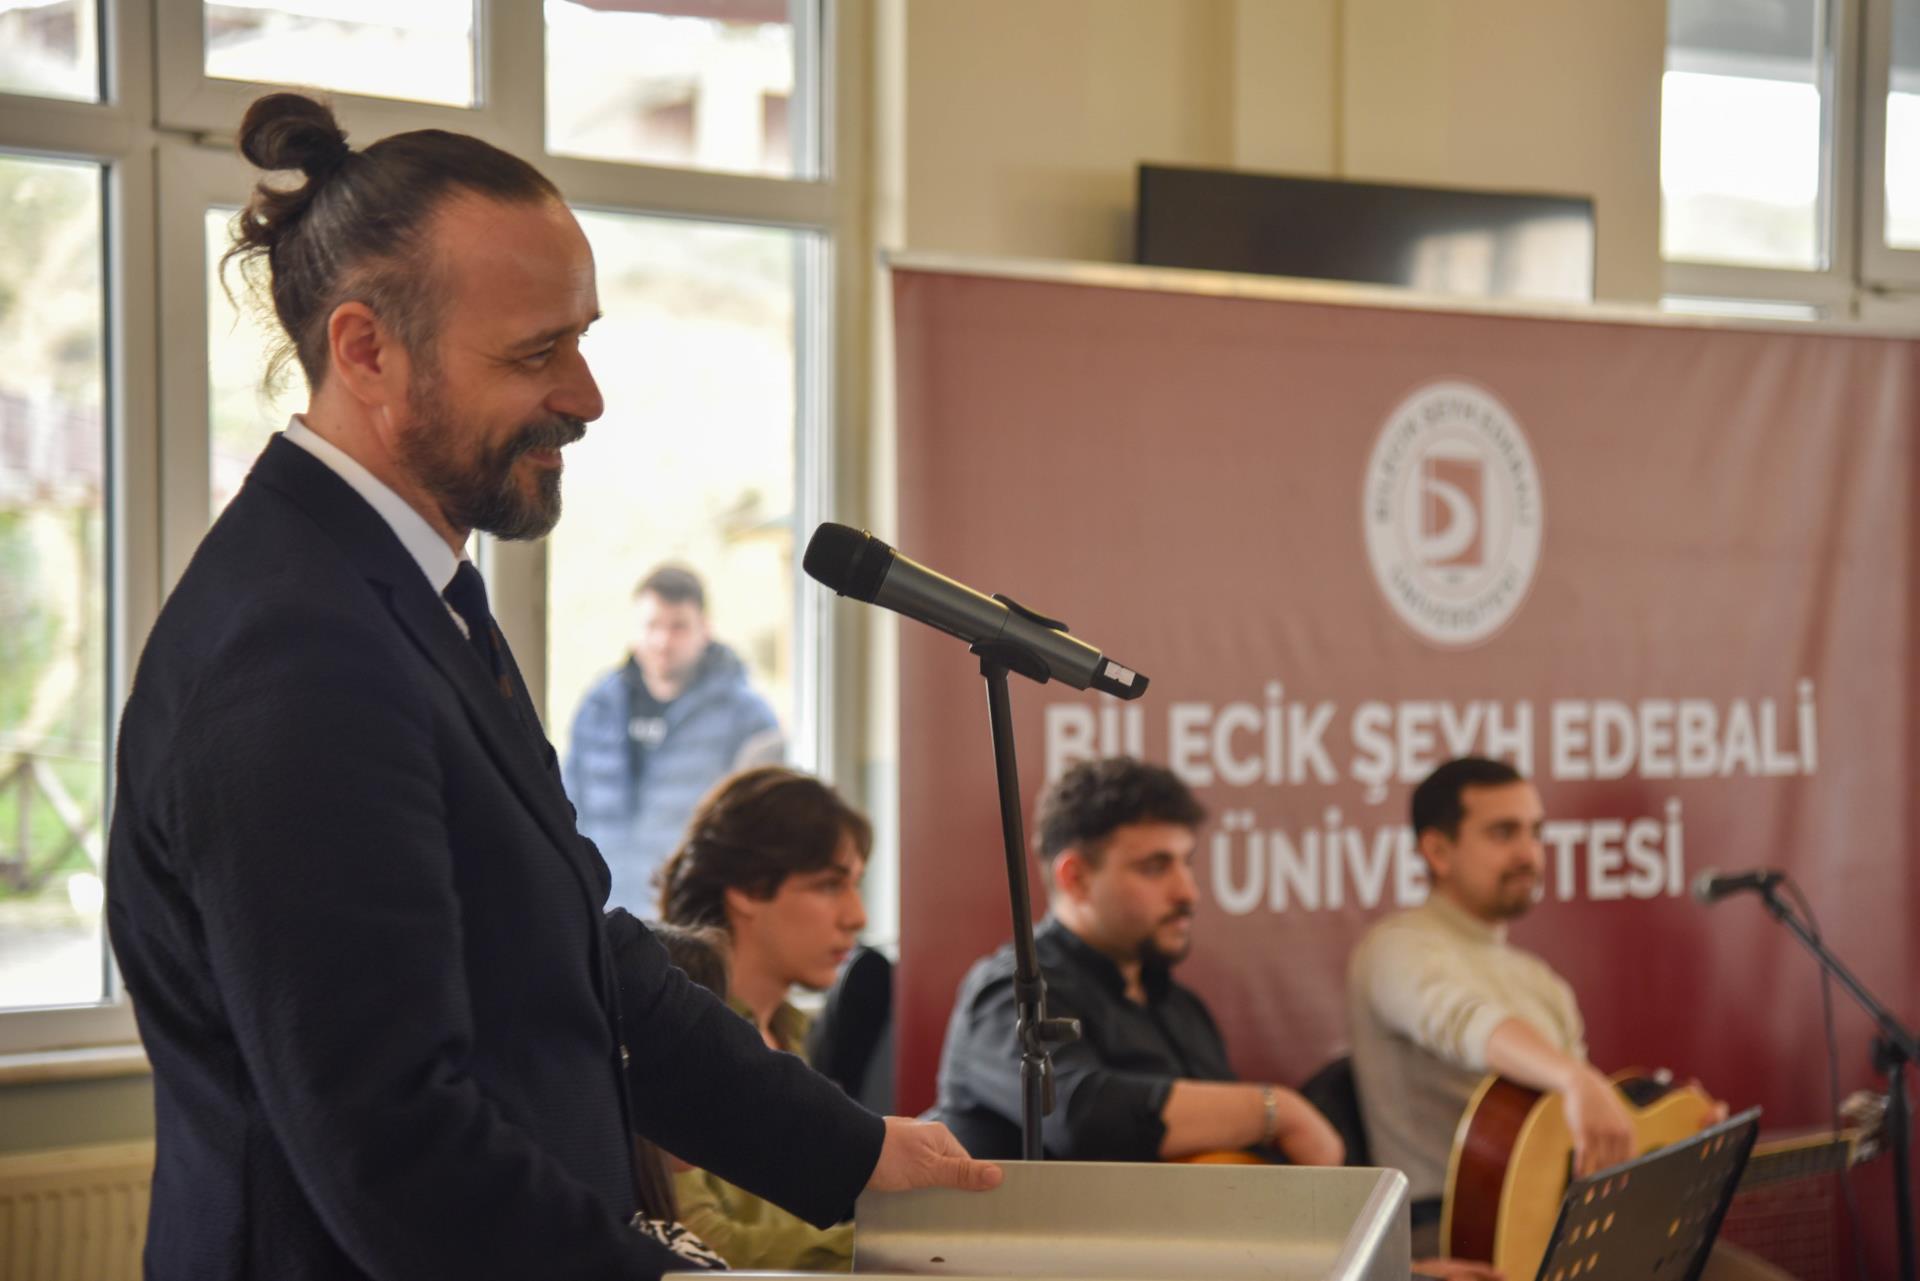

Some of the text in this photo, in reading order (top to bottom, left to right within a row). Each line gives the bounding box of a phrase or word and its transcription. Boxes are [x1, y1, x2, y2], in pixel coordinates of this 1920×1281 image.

[1351, 700, 1534, 804] ŞEYH
[1551, 680, 1818, 781] EDEBALİ
[1211, 799, 1684, 915] ÜNİVETESİ
